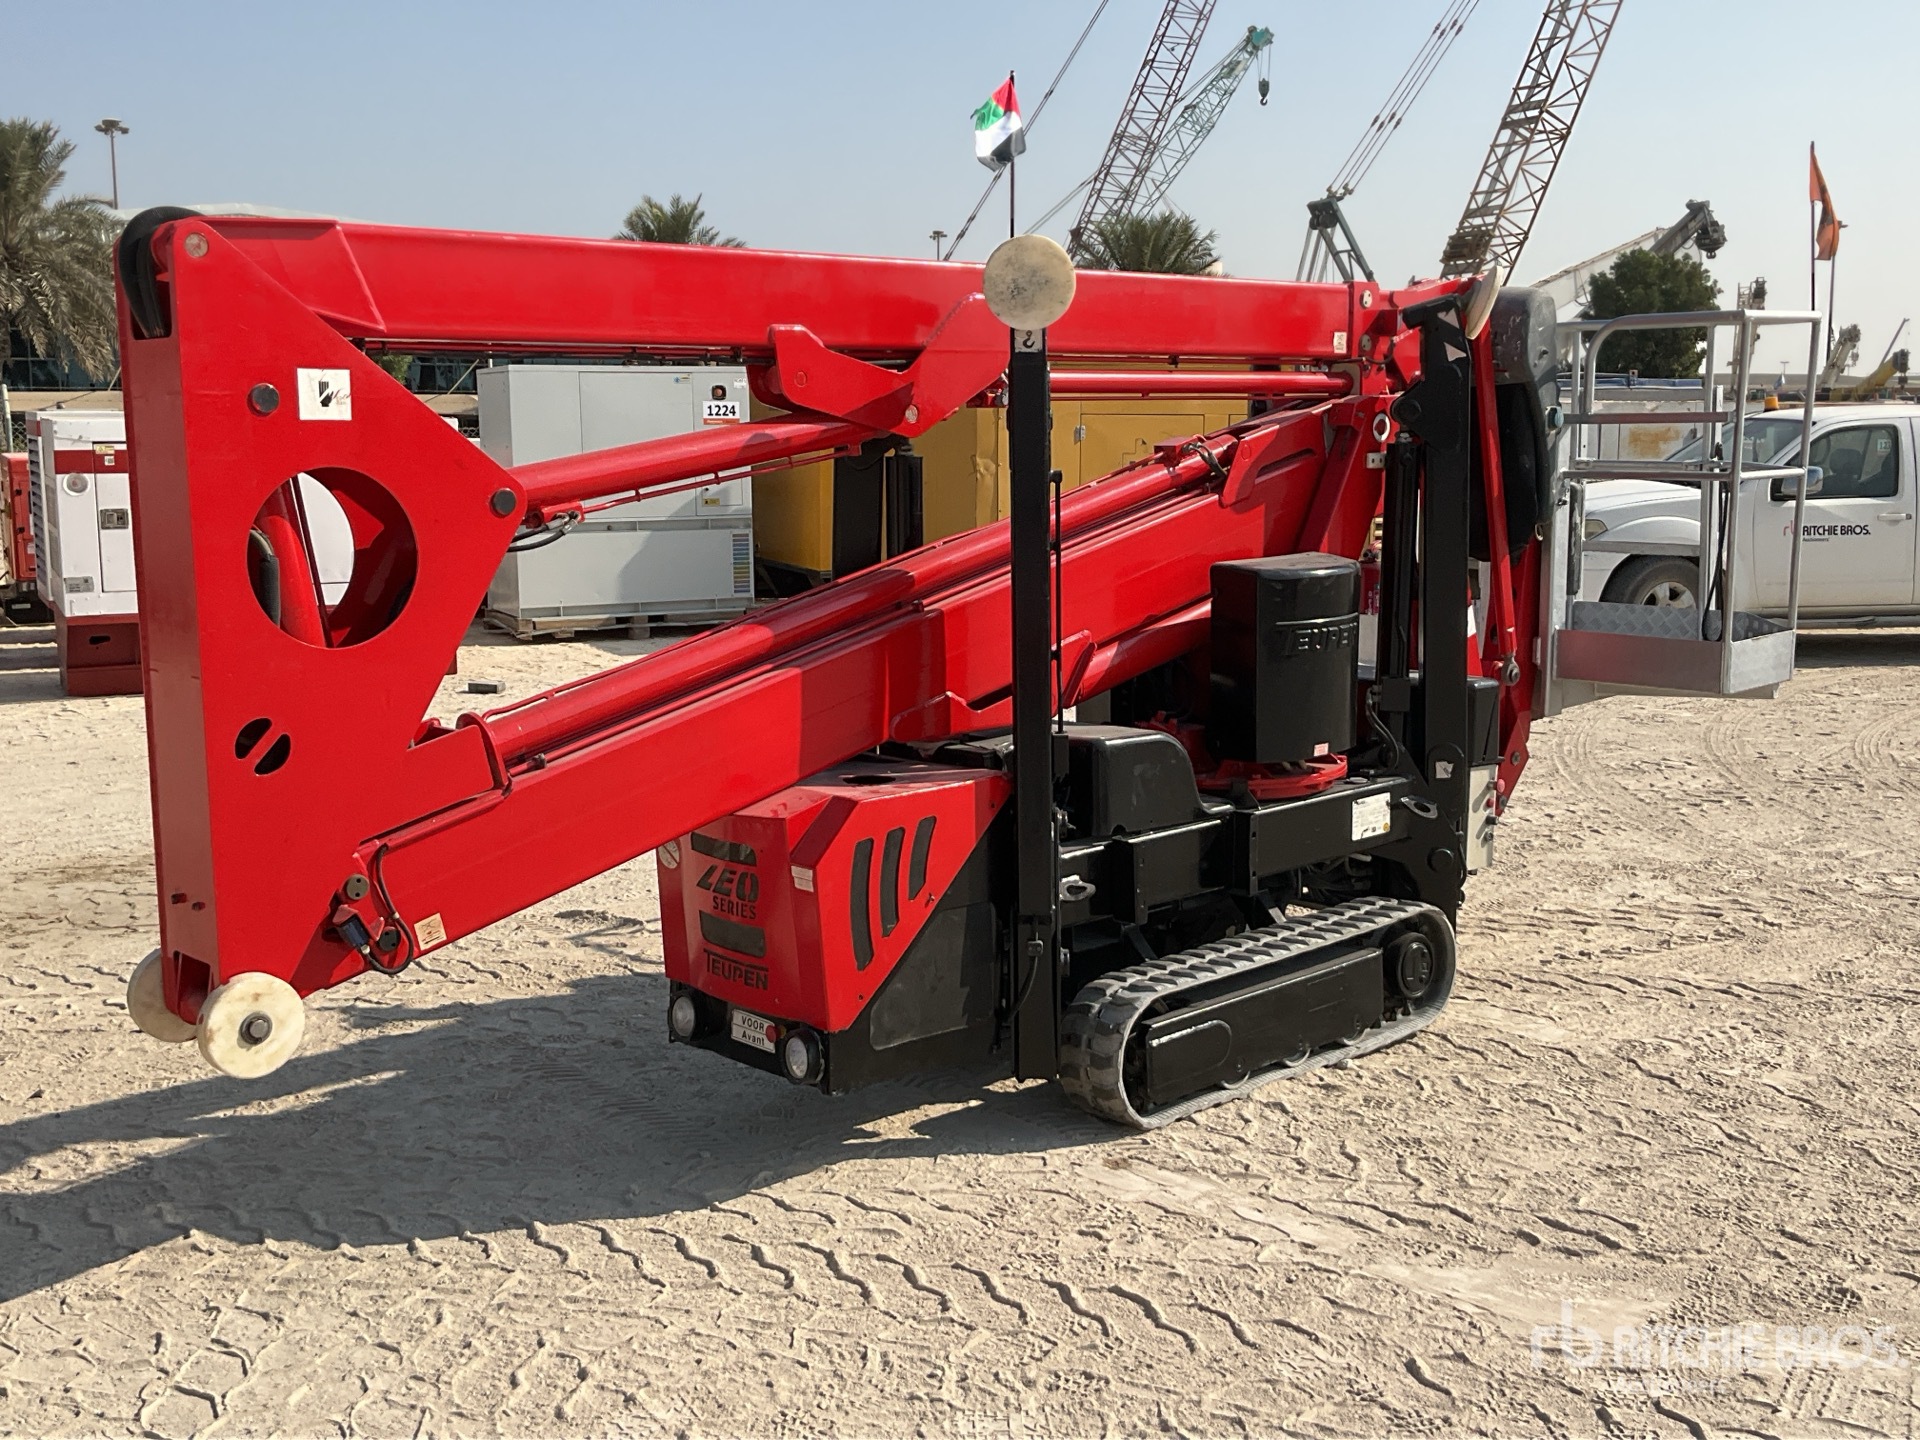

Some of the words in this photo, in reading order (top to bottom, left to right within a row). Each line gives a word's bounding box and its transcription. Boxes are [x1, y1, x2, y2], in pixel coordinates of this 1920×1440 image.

[707, 404, 736, 417] 1224
[1802, 525, 1838, 536] RITCHIE
[1840, 524, 1871, 536] BROS.
[696, 864, 760, 903] LEO
[712, 895, 757, 920] SERIES
[703, 948, 769, 990] TEUPEN
[741, 1015, 765, 1032] VOOR
[741, 1030, 765, 1046] Avant
